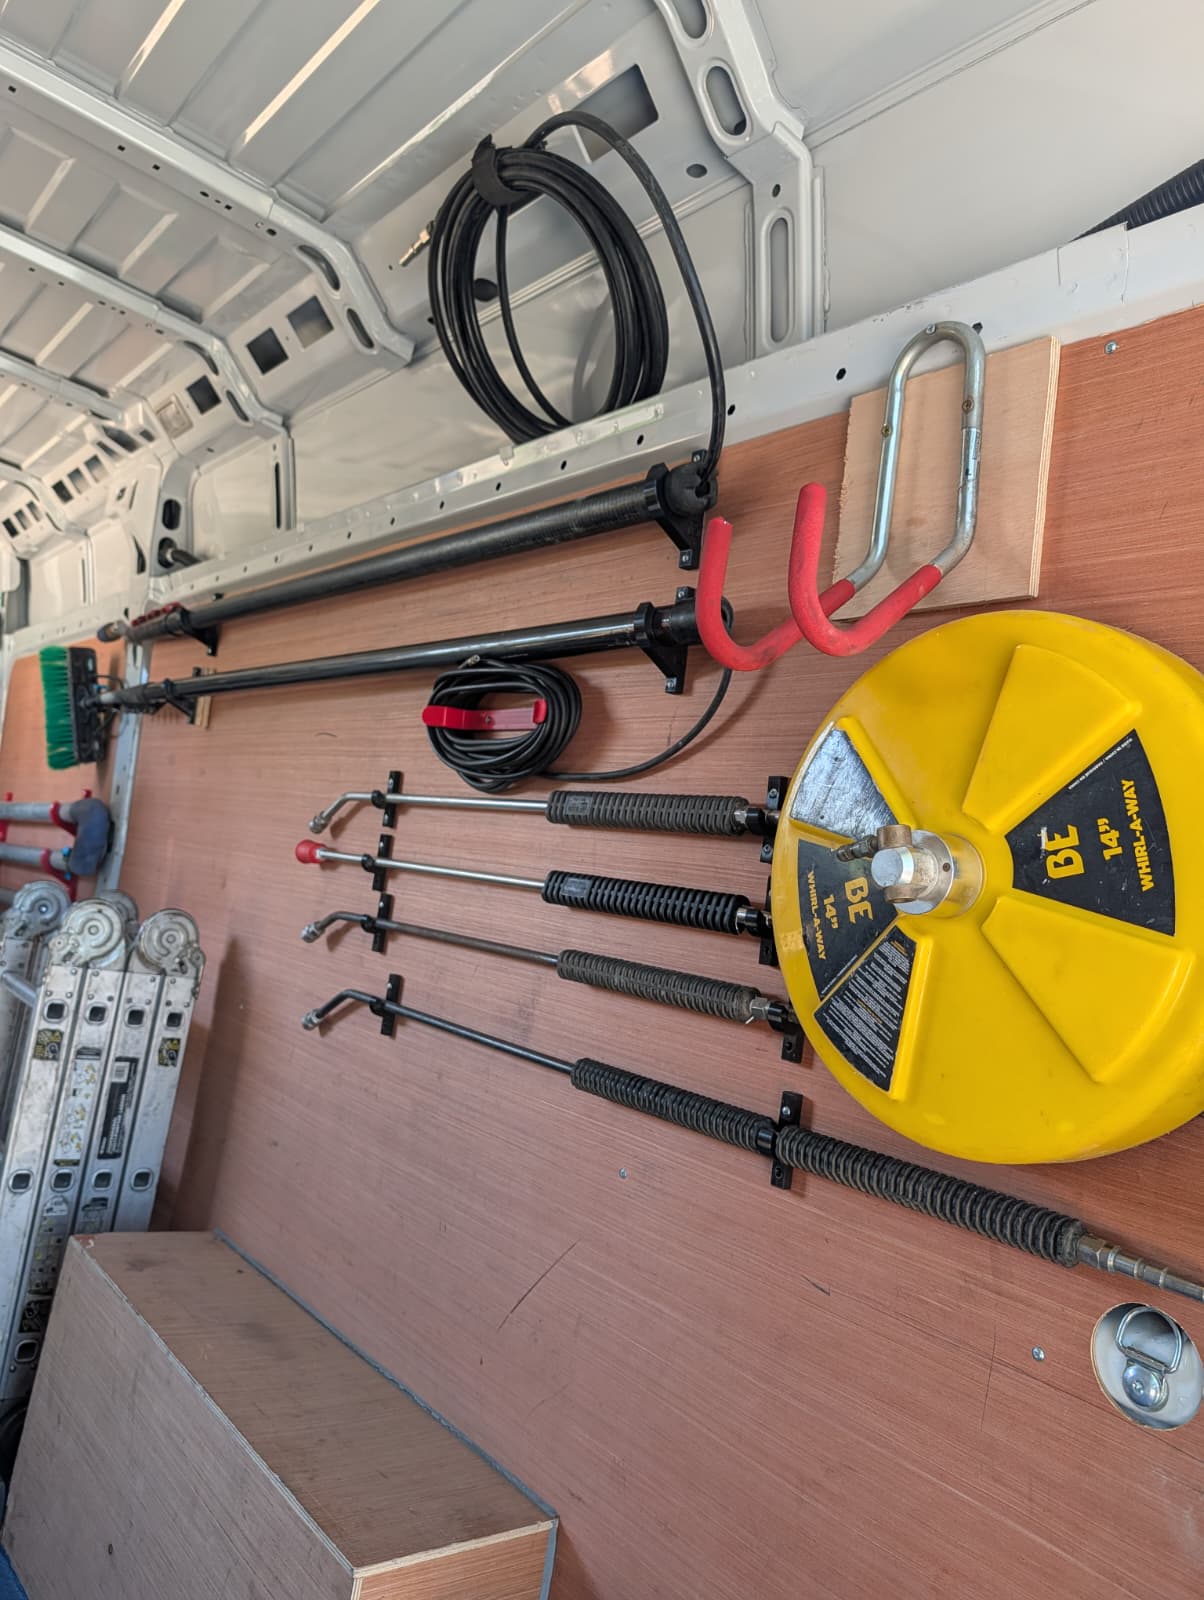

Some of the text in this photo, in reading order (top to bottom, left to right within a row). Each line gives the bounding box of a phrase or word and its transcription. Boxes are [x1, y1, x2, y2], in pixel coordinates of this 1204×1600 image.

[1045, 824, 1086, 880] BE
[1121, 779, 1155, 892] WHIRL-A-WAY
[807, 870, 827, 961] WHIRL-A-WAY
[844, 876, 874, 925] BE
